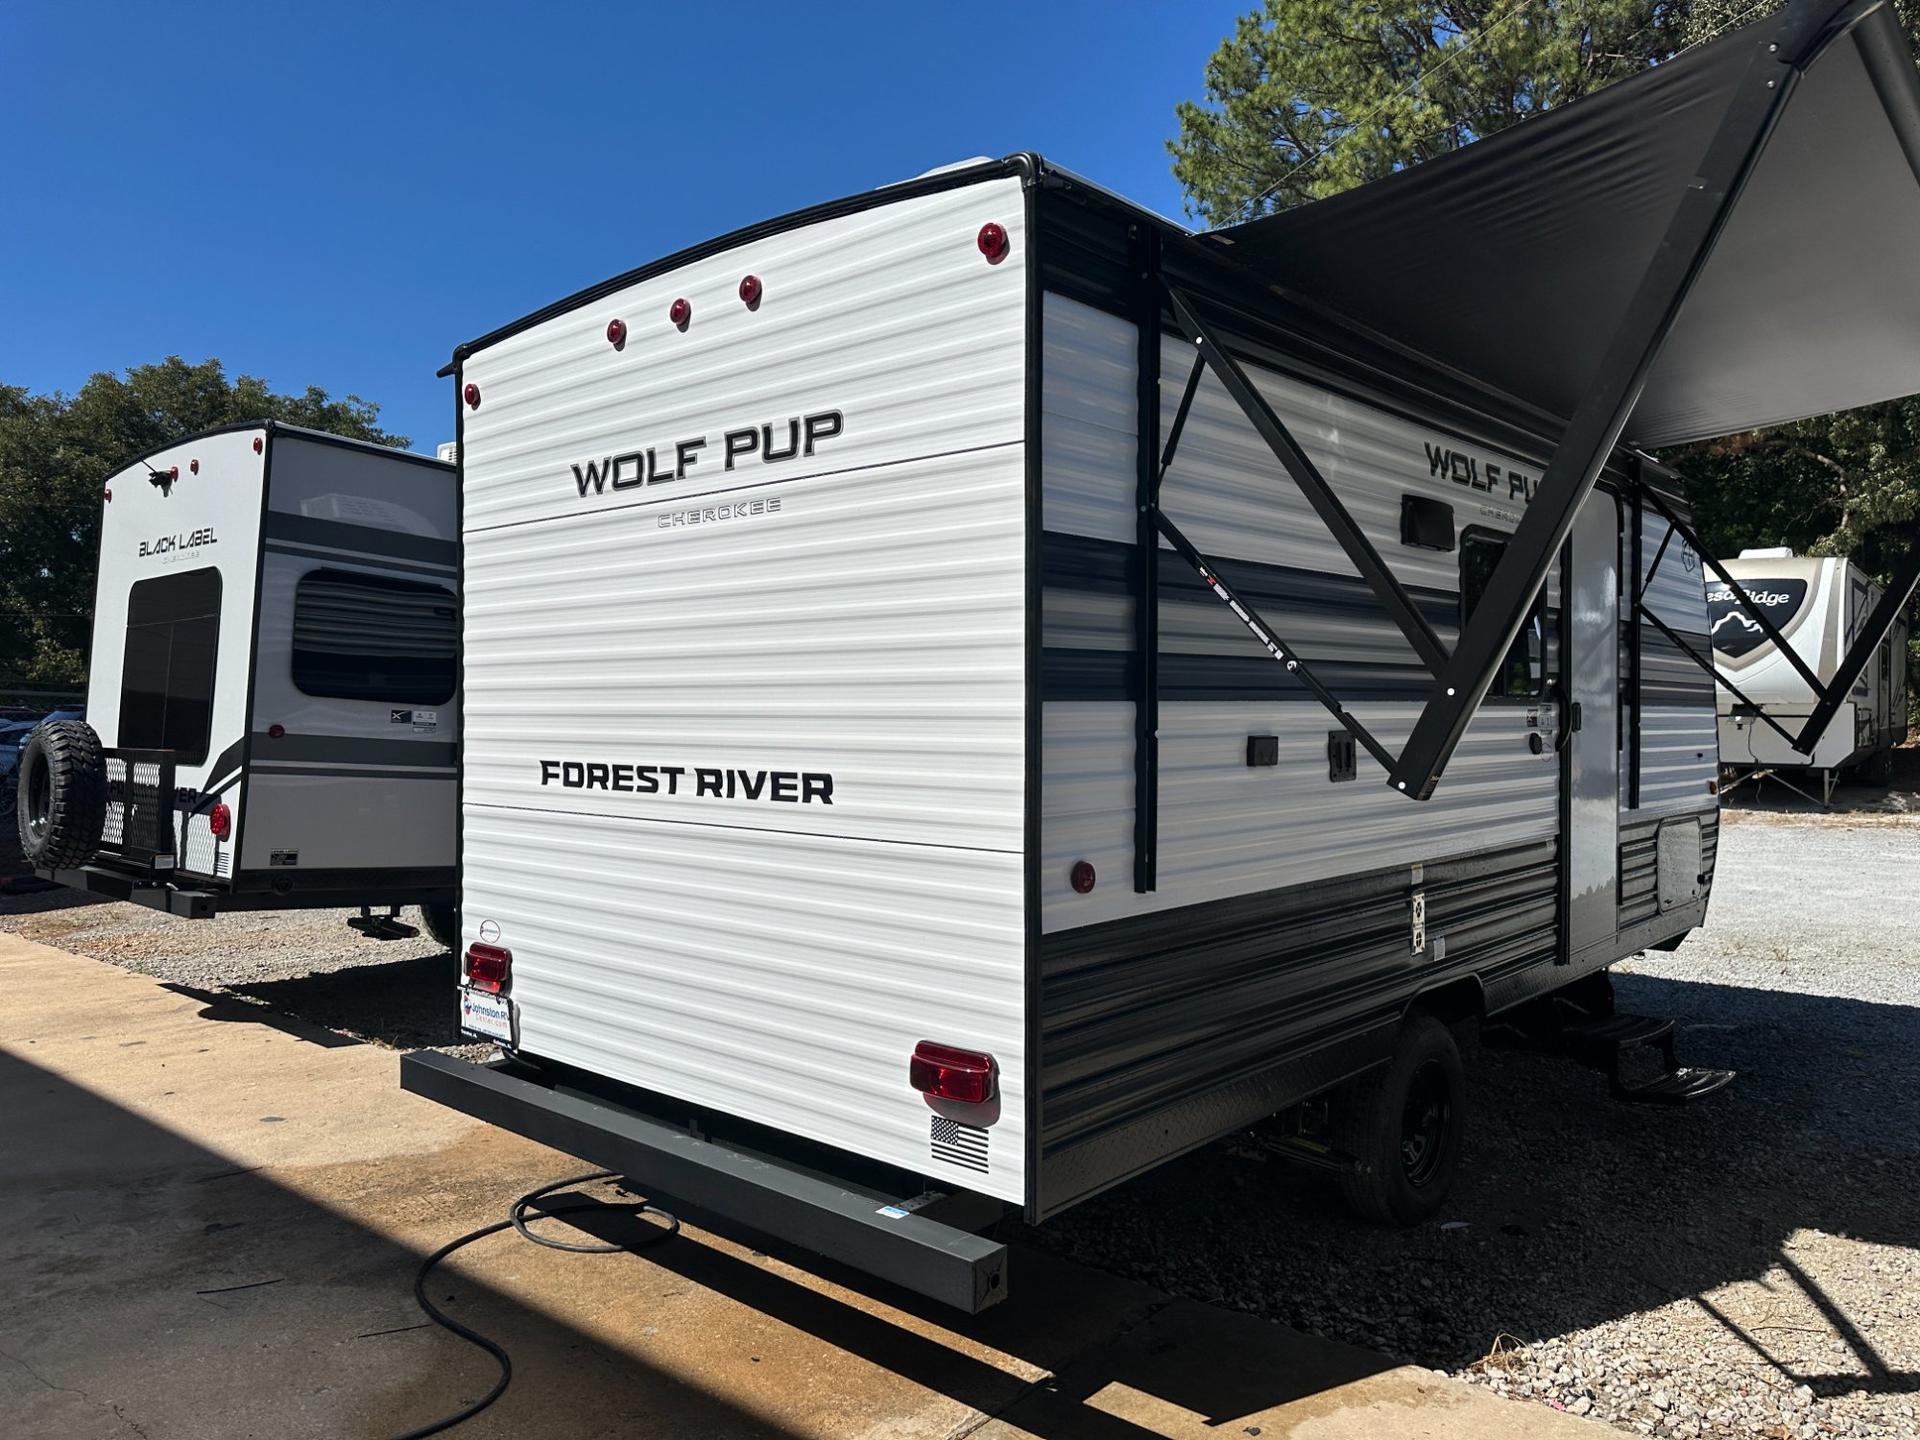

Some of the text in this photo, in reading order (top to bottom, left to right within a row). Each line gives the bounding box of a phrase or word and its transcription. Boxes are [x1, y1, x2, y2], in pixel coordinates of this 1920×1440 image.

[570, 408, 845, 498] WOLF PUP
[1424, 440, 1539, 503] WOLF PU
[657, 496, 782, 529] CHEROKEE
[139, 534, 176, 557] BLACK
[179, 527, 218, 550] LABEL
[1706, 590, 1737, 603] esa
[539, 759, 834, 805] FOREST RIVER
